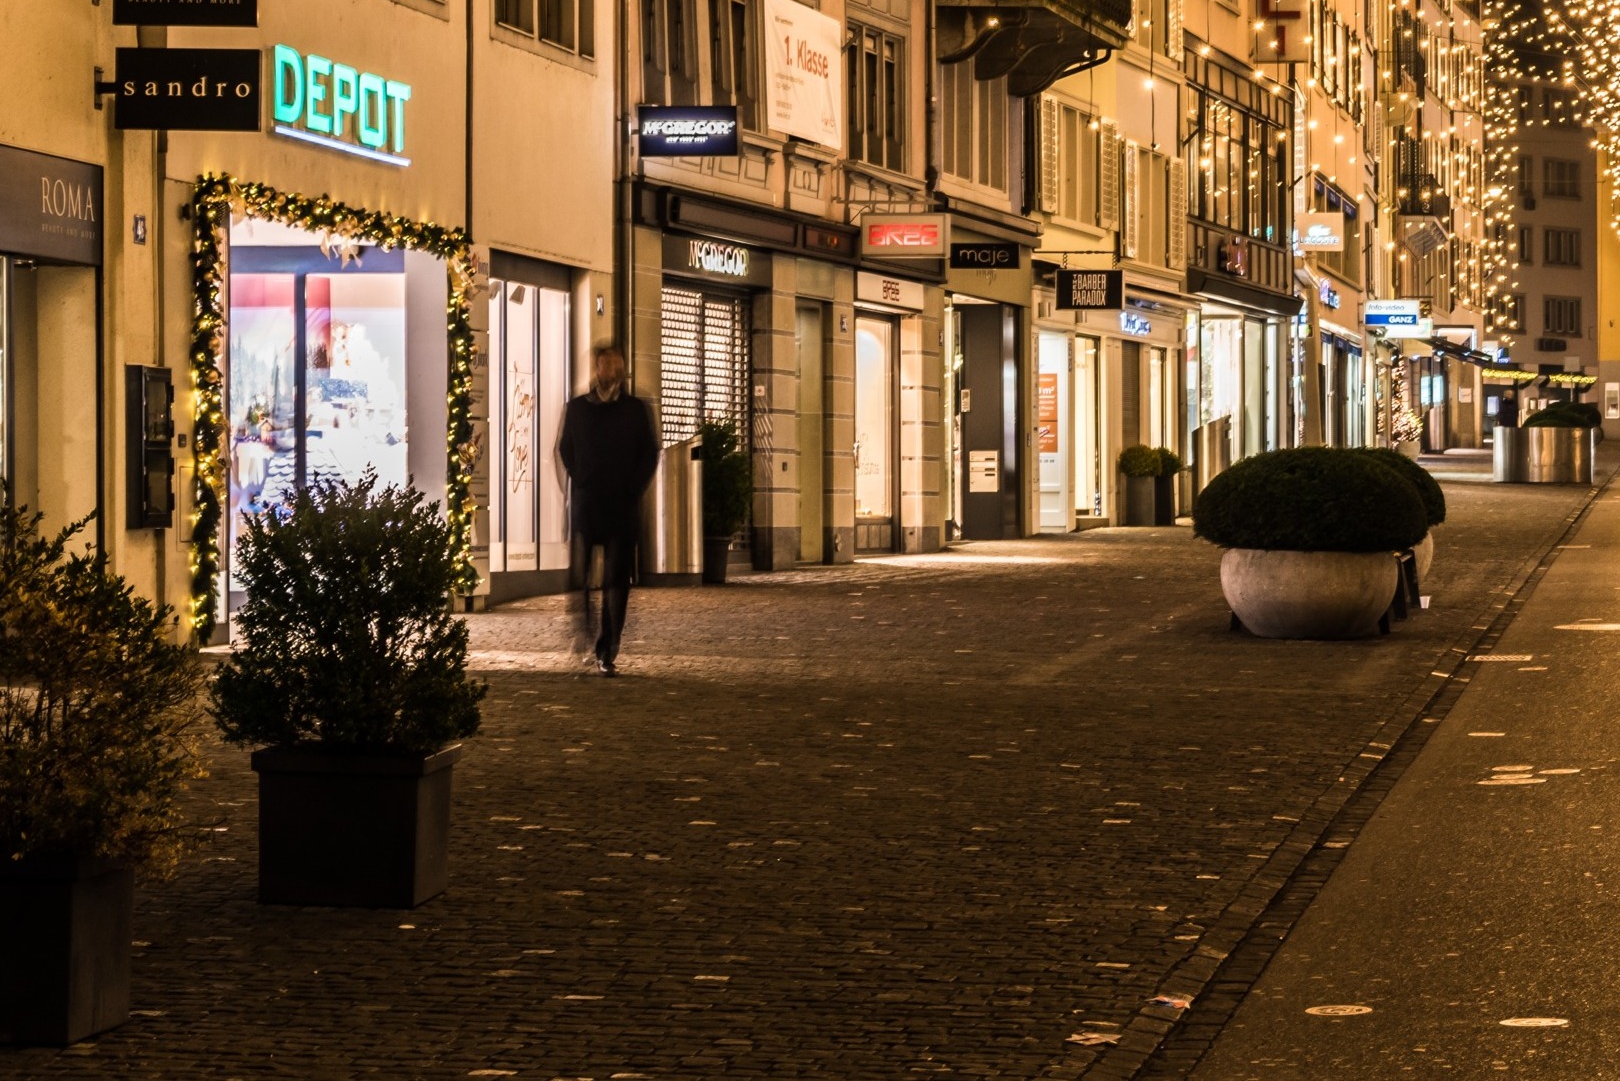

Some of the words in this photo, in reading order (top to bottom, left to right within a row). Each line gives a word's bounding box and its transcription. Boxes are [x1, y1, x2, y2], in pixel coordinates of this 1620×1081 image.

[784, 35, 793, 66] 1.
[797, 38, 829, 80] Klasse
[124, 76, 250, 98] sandro
[274, 43, 412, 153] DEPOT
[41, 177, 95, 222] ROMA
[959, 248, 1010, 266] maje
[1078, 274, 1107, 290] BARBER
[1072, 291, 1107, 306] PARADOX
